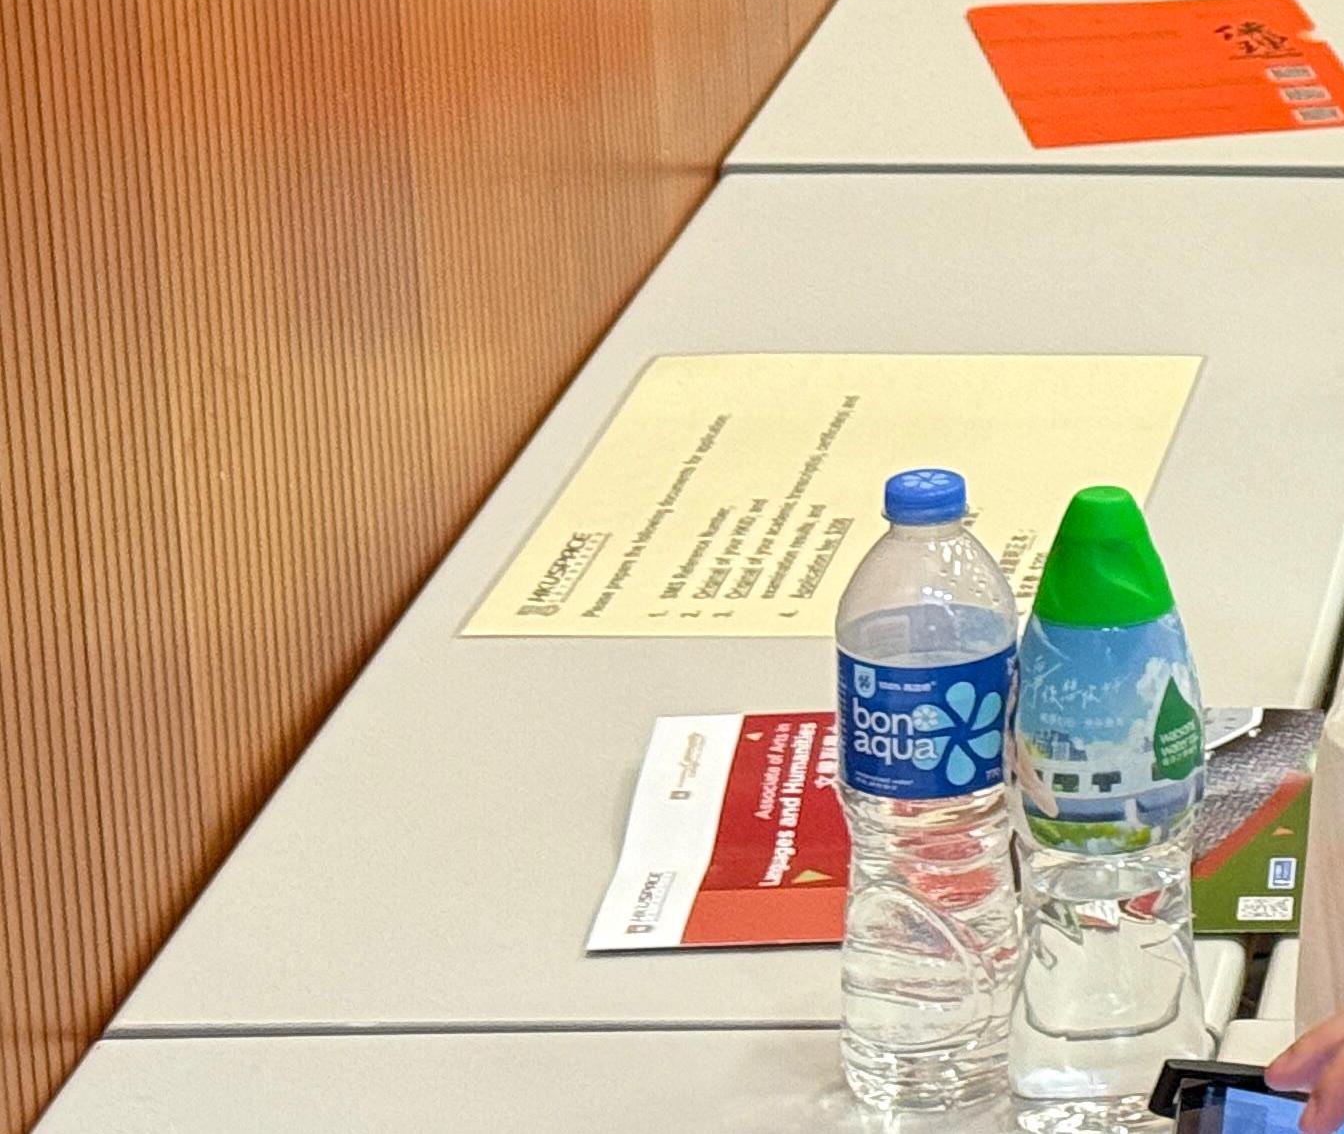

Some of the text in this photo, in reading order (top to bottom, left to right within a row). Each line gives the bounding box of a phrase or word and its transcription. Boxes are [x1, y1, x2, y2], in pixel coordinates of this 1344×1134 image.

[852, 697, 914, 736] bon
[782, 722, 817, 794] Humanities
[853, 730, 939, 765] aqua
[754, 723, 792, 820] Associate of Arts in
[779, 796, 801, 827] and
